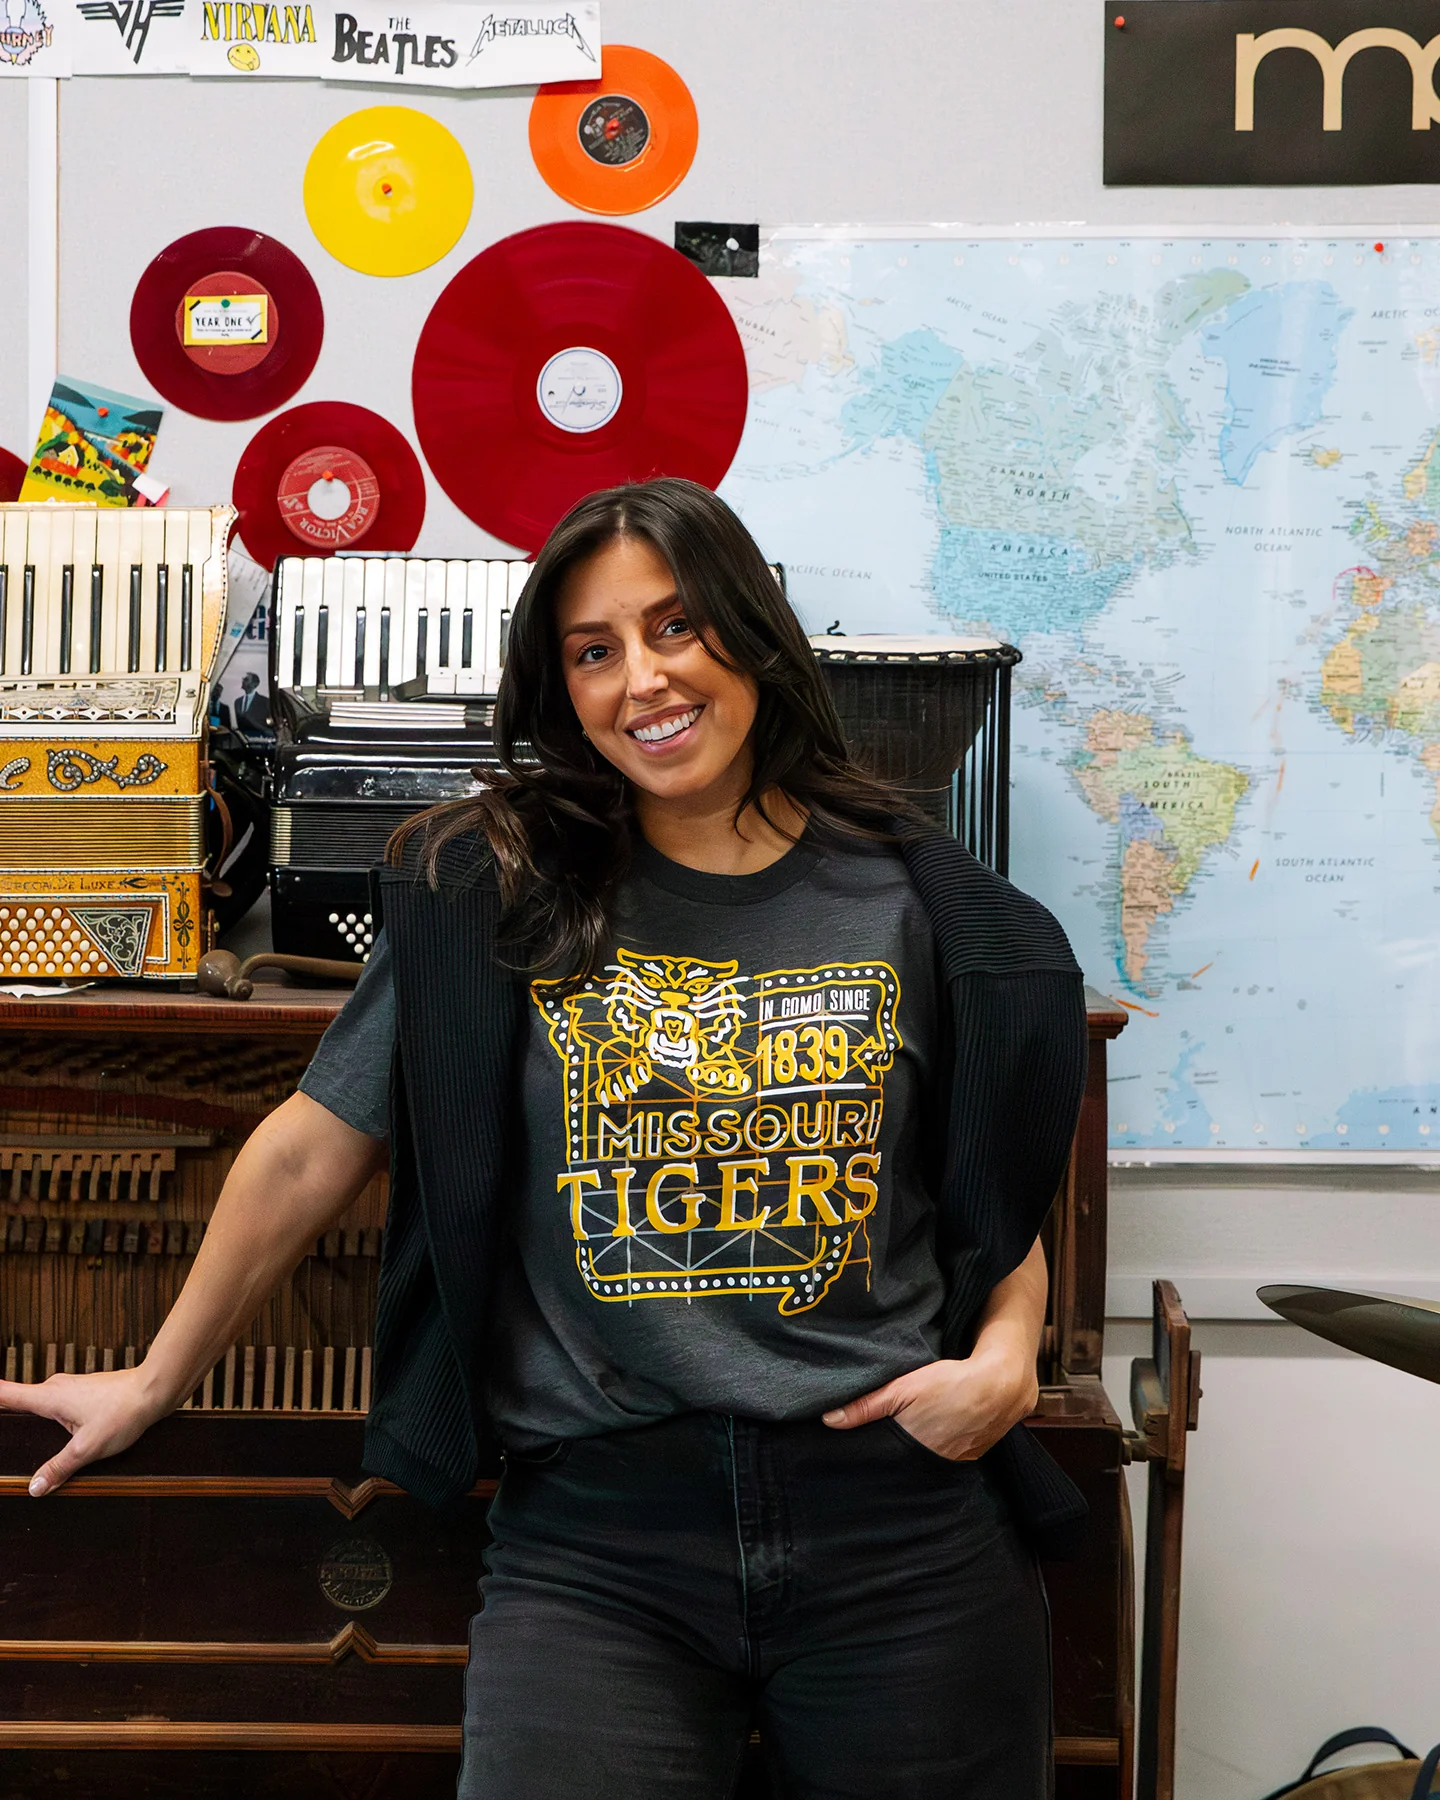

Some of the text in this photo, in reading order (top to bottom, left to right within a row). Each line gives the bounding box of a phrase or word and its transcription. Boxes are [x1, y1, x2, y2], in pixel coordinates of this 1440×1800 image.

[201, 1, 317, 43] NIRVANA
[388, 16, 411, 31] THE
[332, 12, 459, 75] BEATLES
[195, 316, 242, 327] YEAR ONE
[990, 465, 1045, 481] CANADA
[1013, 487, 1071, 501] NORTH
[346, 505, 369, 530] RCA
[299, 516, 352, 544] VICTOR
[1224, 525, 1324, 538] NORTH ATLANTIC
[989, 543, 1069, 557] AMERICA
[1253, 541, 1293, 553] OCEAN
[785, 563, 827, 577] ACIFIC
[978, 571, 1049, 583] UNITED STATES
[1143, 780, 1191, 790] SOUTH
[1138, 800, 1205, 811] AMERICA
[1275, 856, 1376, 868] SOUTH ATLANTIC
[1304, 873, 1345, 883] OCEAN
[759, 988, 871, 1022] IN COMO SINCE
[756, 1025, 848, 1086] 1839
[598, 1101, 883, 1160] MISSOURI
[556, 1151, 882, 1241] TIGERS
